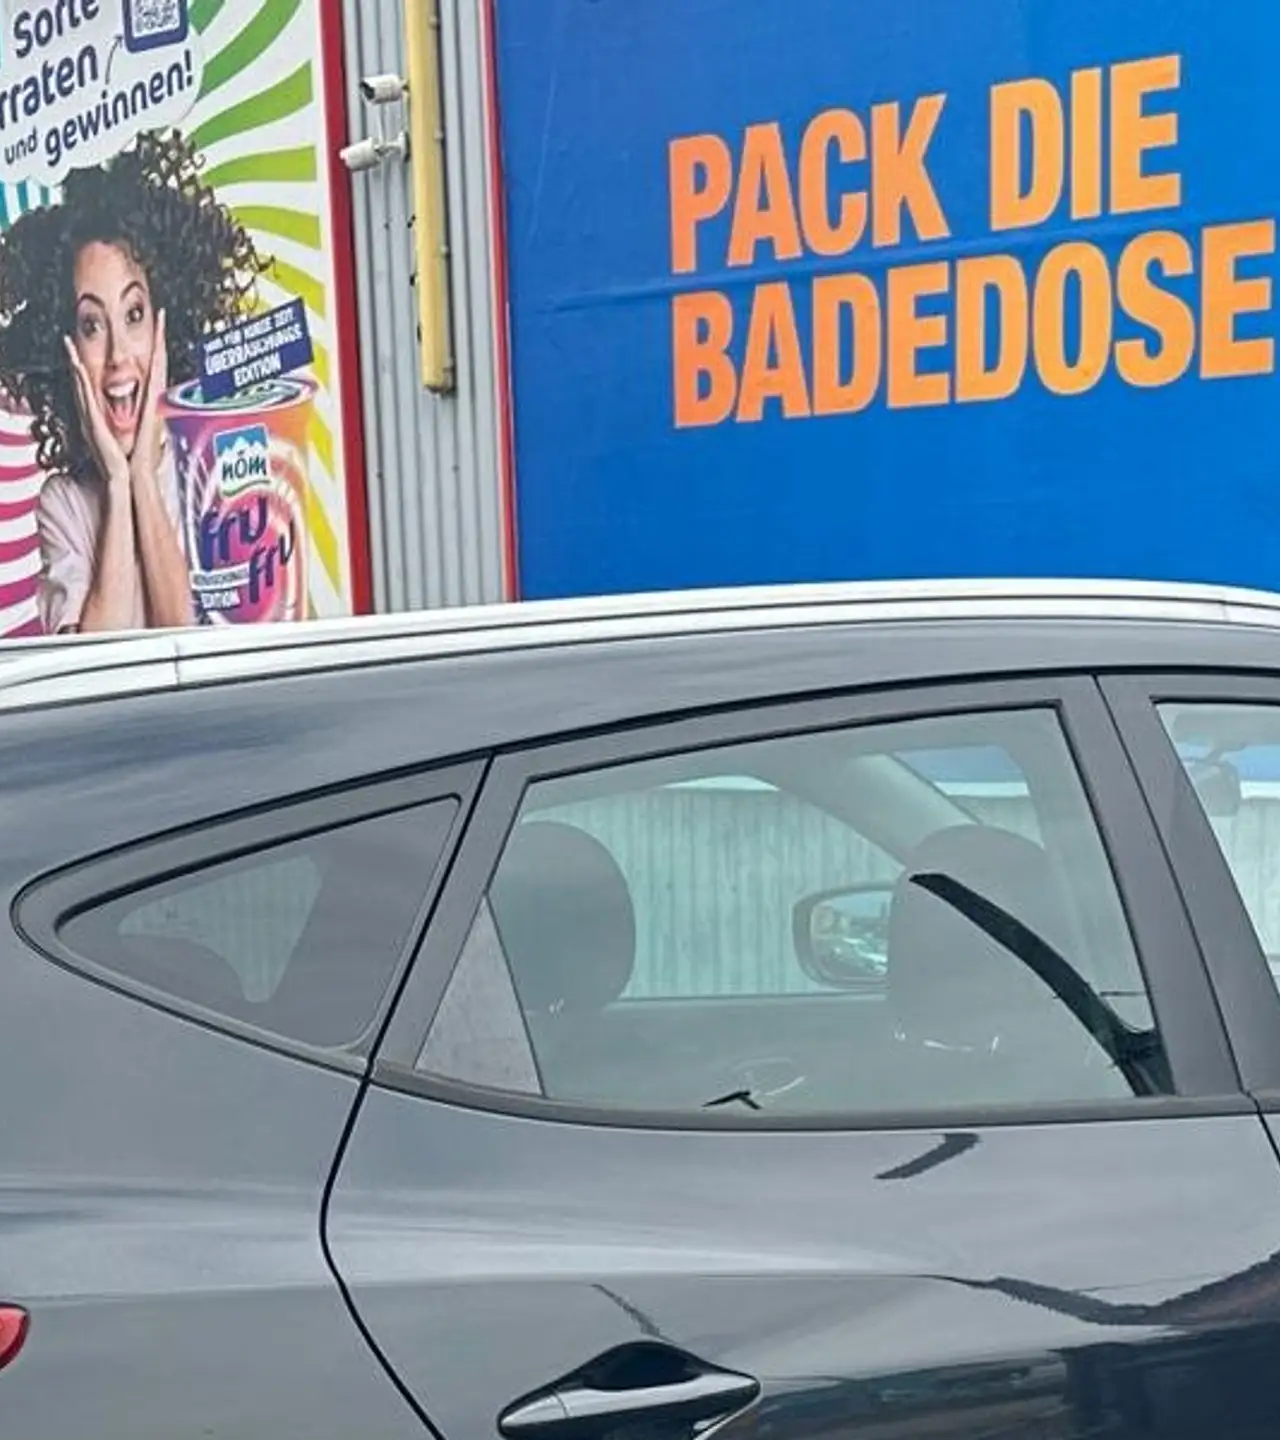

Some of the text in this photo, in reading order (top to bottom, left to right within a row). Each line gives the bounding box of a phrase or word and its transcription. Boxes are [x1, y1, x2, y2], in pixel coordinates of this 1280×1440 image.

[4, 49, 193, 167] und gewinnen!
[667, 53, 1183, 275] PACK DIE
[233, 351, 282, 388] EDITION
[671, 218, 1276, 429] BADEDOSE
[201, 497, 267, 571] fru
[249, 518, 295, 604] fru
